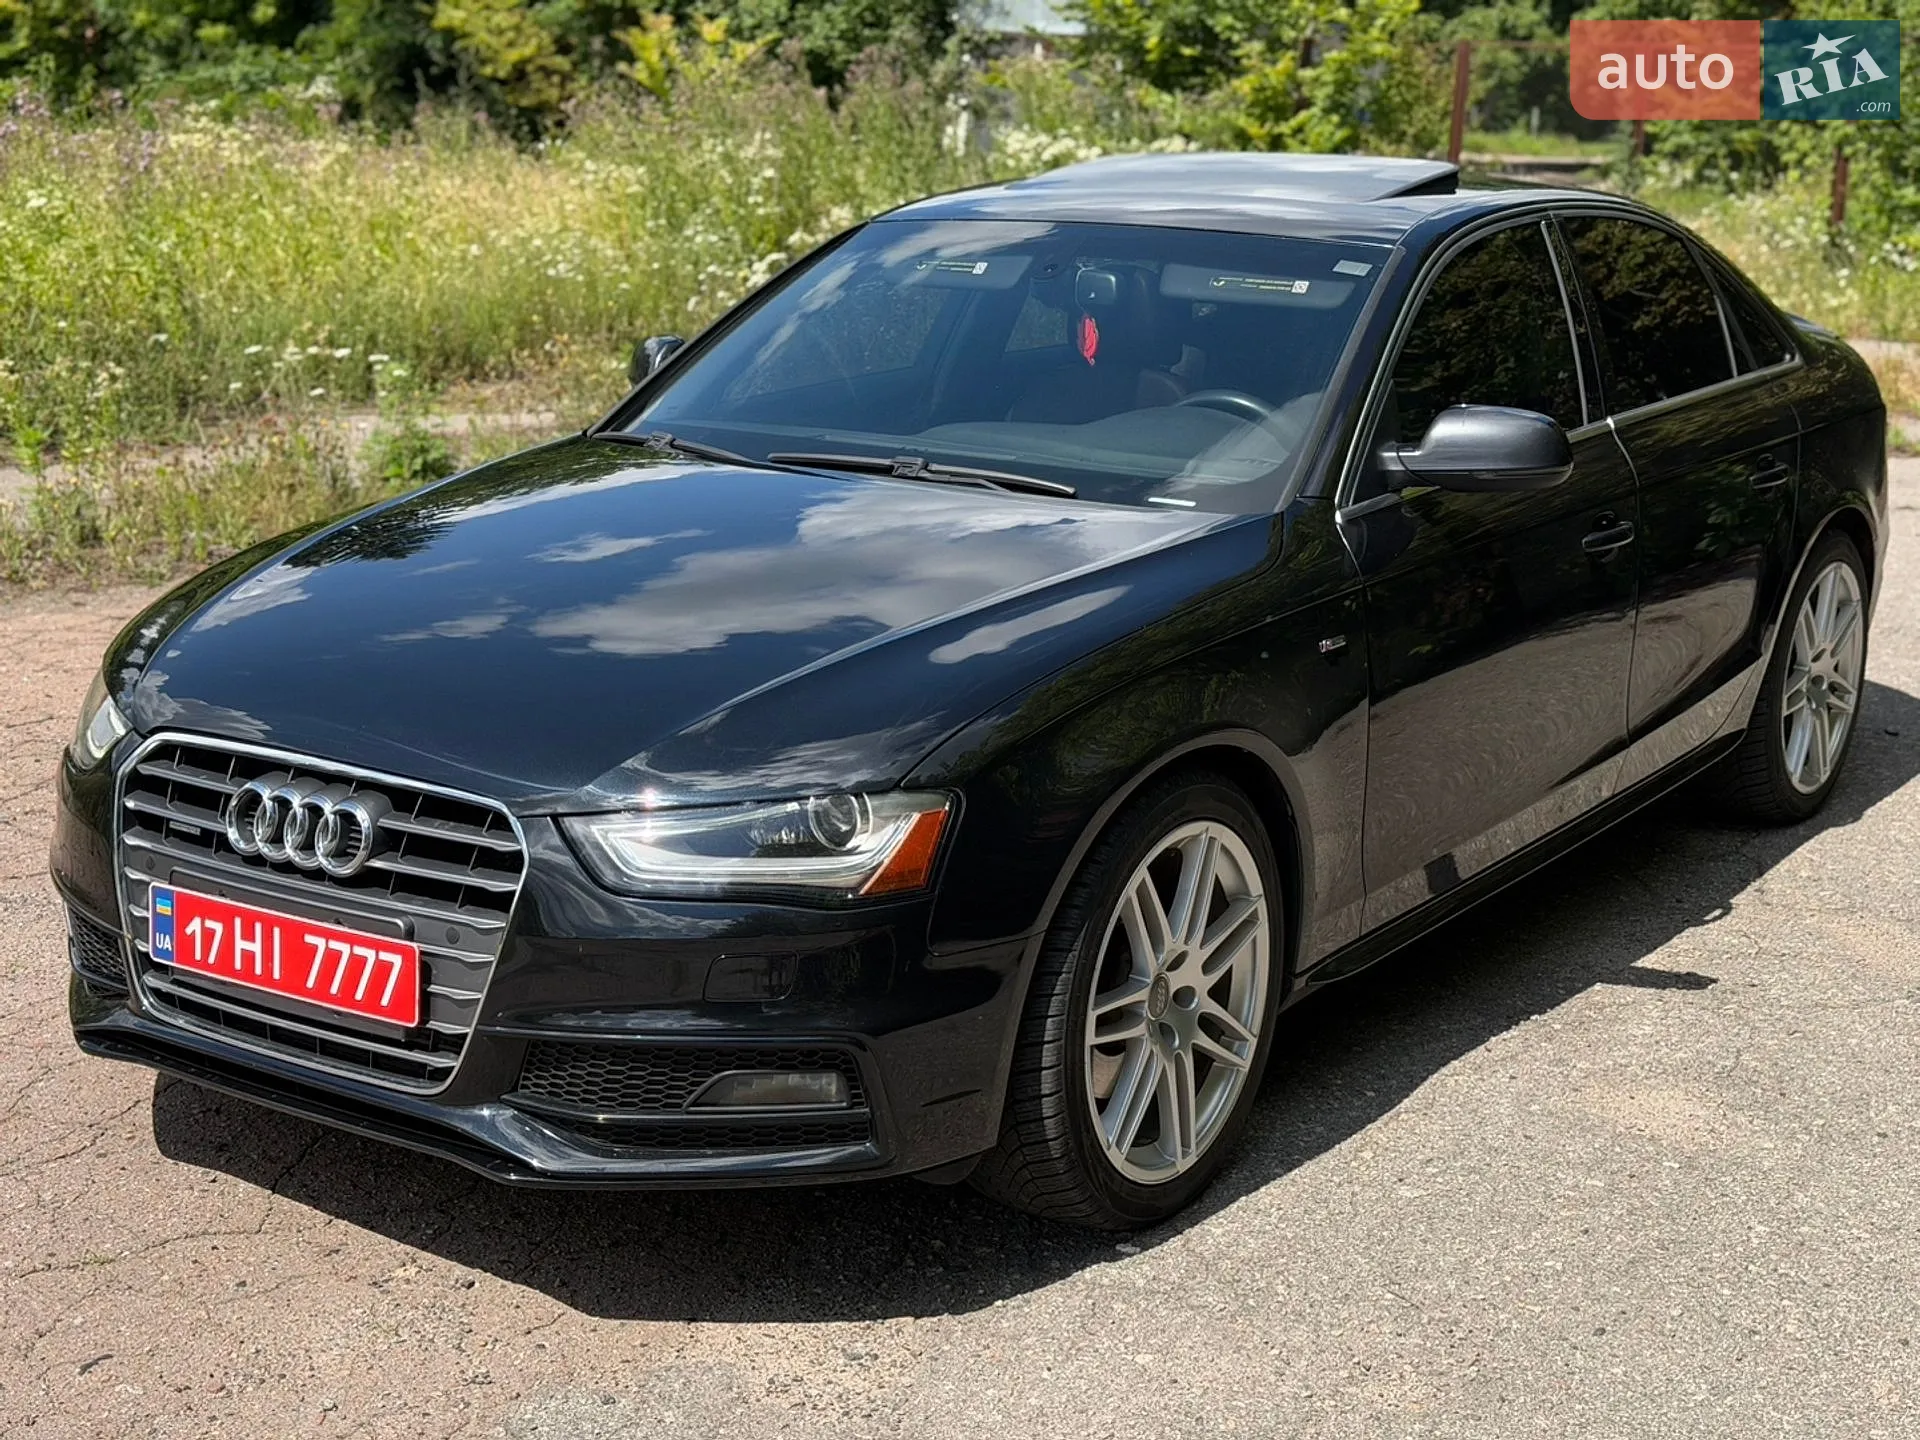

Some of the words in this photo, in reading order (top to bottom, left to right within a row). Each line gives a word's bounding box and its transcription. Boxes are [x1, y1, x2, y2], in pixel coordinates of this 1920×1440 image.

[155, 932, 172, 952] UA
[184, 915, 224, 965] 17
[233, 916, 282, 981] HI
[303, 933, 403, 1008] 7777
